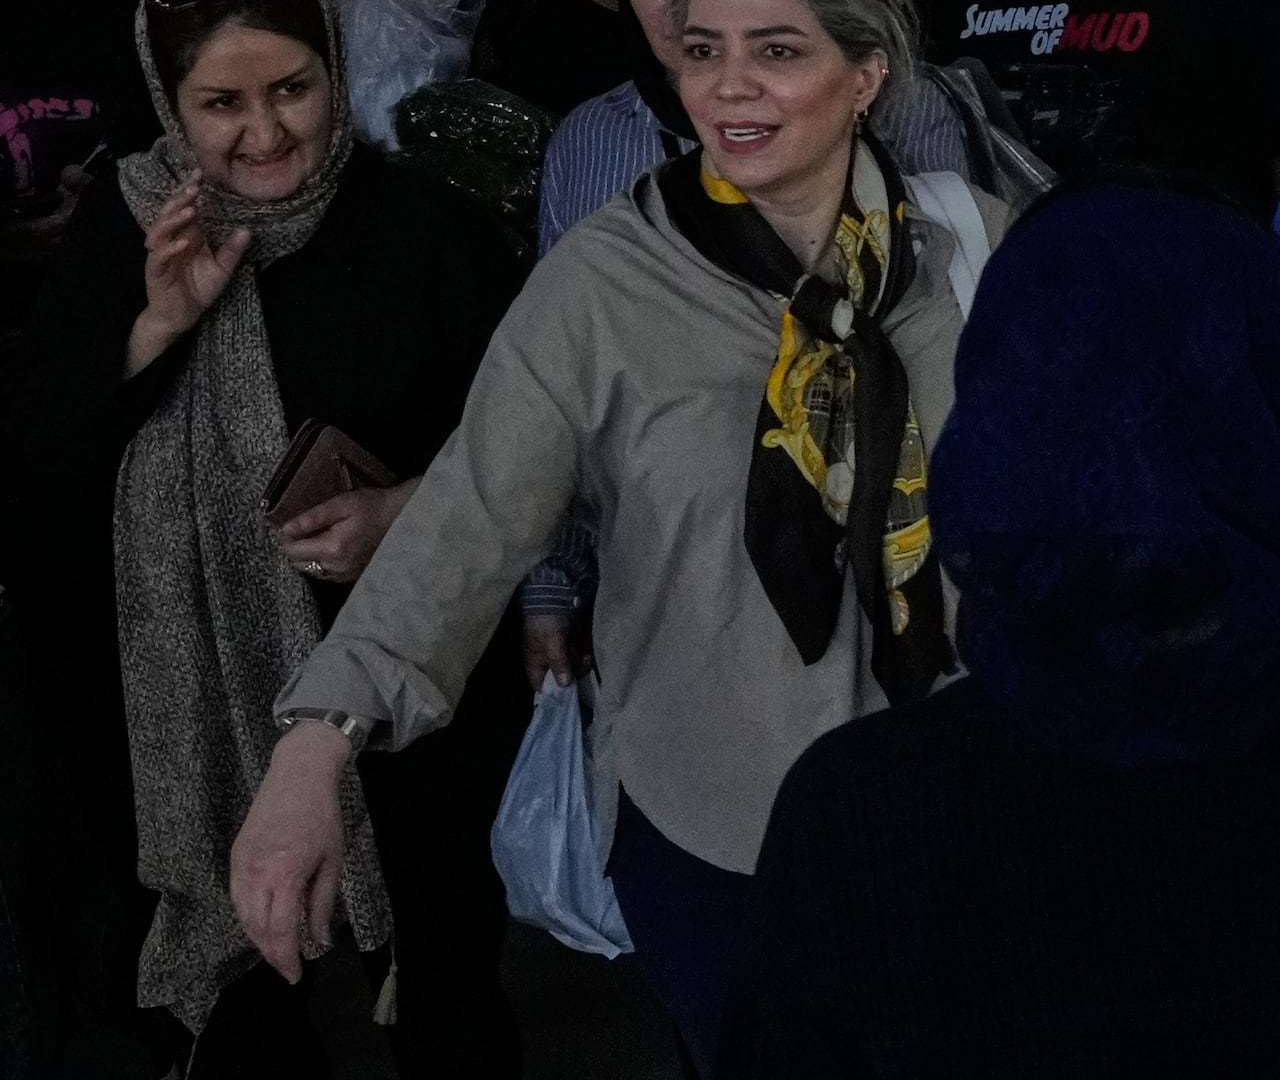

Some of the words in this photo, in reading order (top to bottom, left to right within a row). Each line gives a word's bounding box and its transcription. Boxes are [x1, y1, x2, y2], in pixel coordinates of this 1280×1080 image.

[959, 3, 1070, 39] SUMMER
[1060, 10, 1150, 53] MUD
[1030, 28, 1063, 55] OF
